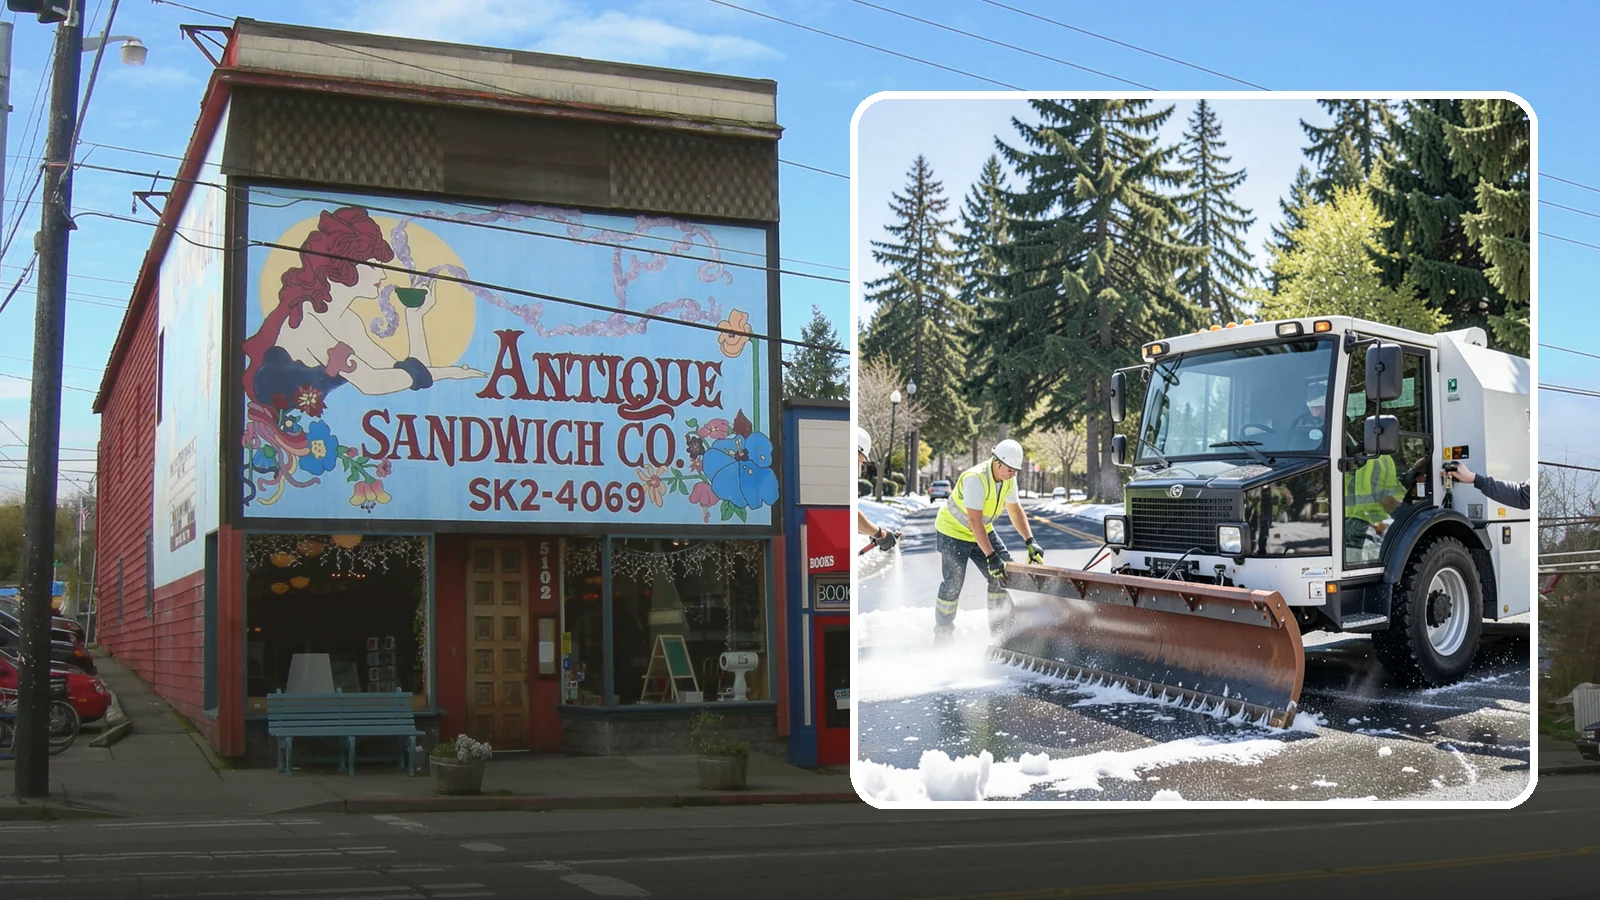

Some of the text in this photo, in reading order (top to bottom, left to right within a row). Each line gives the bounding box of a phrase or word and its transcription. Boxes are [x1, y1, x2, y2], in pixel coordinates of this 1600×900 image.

[361, 408, 685, 469] SANDWICH CO.
[468, 477, 646, 513] SK2-4069
[540, 541, 552, 600] 5102
[809, 555, 834, 569] BOOKS
